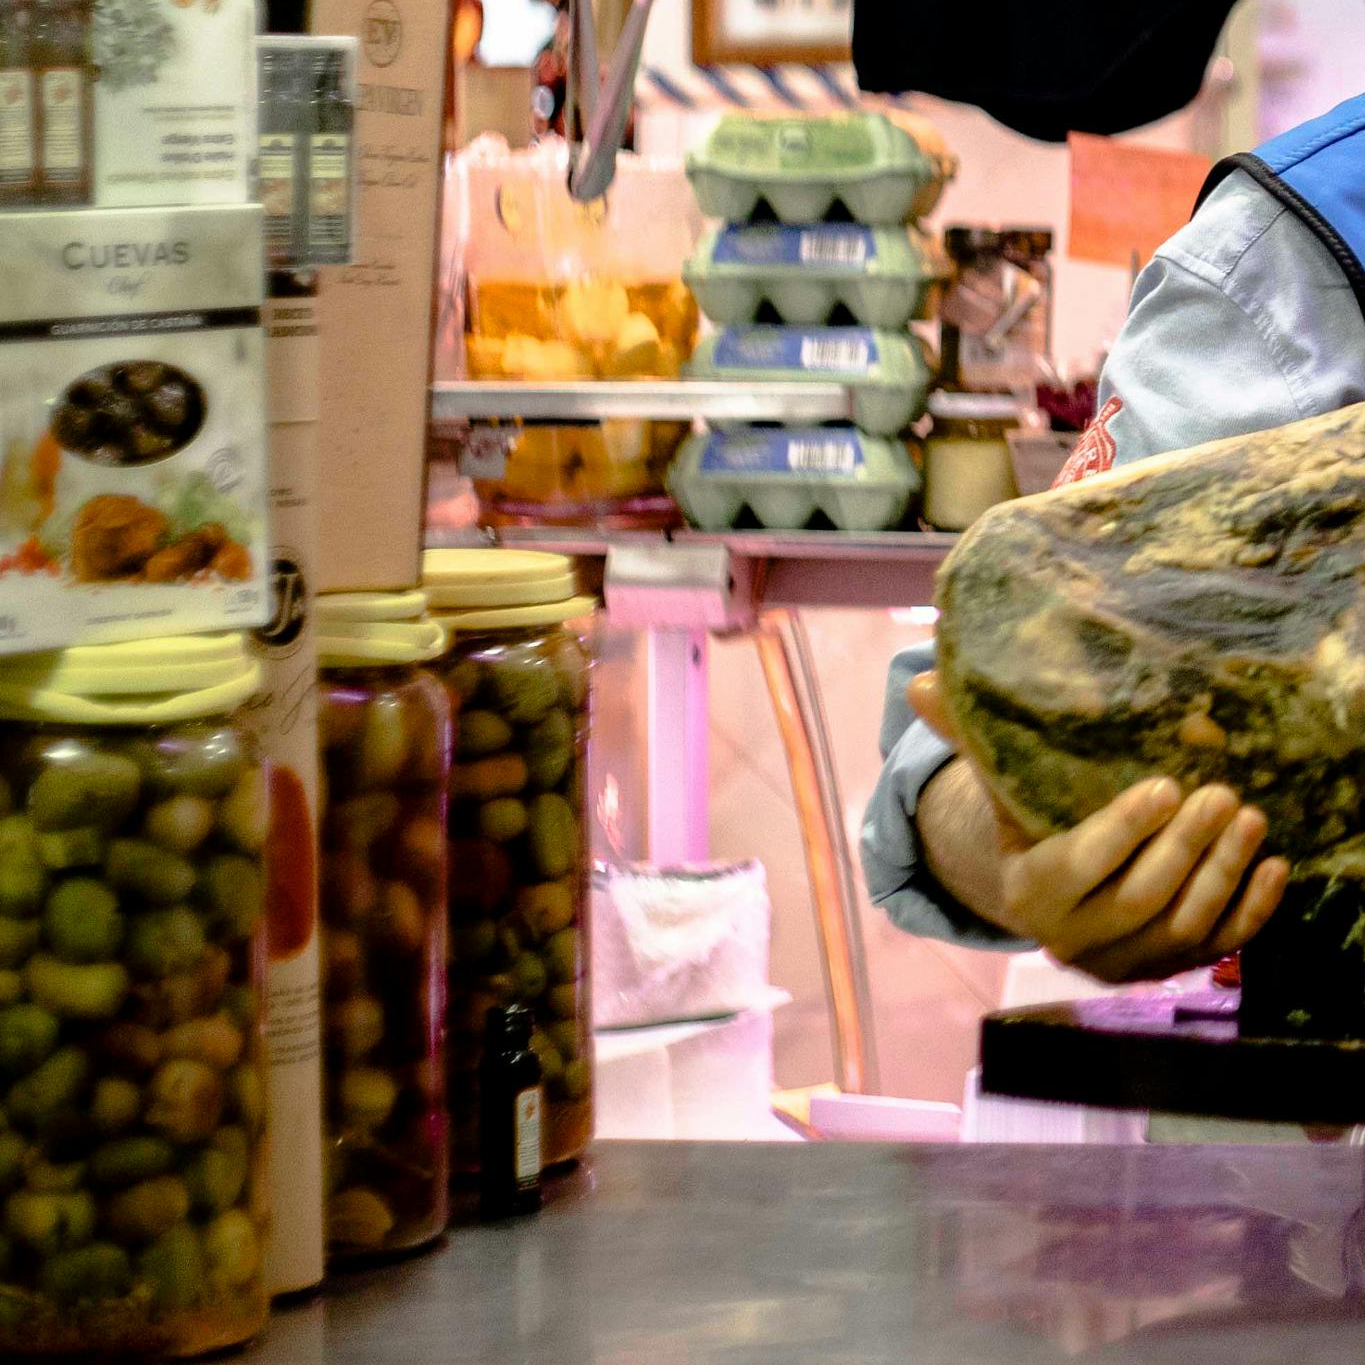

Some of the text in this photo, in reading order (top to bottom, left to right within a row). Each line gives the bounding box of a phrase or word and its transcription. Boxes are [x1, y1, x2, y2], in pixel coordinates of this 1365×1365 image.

[62, 240, 190, 271] CUEVAS
[107, 273, 147, 298] Chef
[51, 317, 129, 335] GUARNICIÓN
[131, 319, 147, 331] DE
